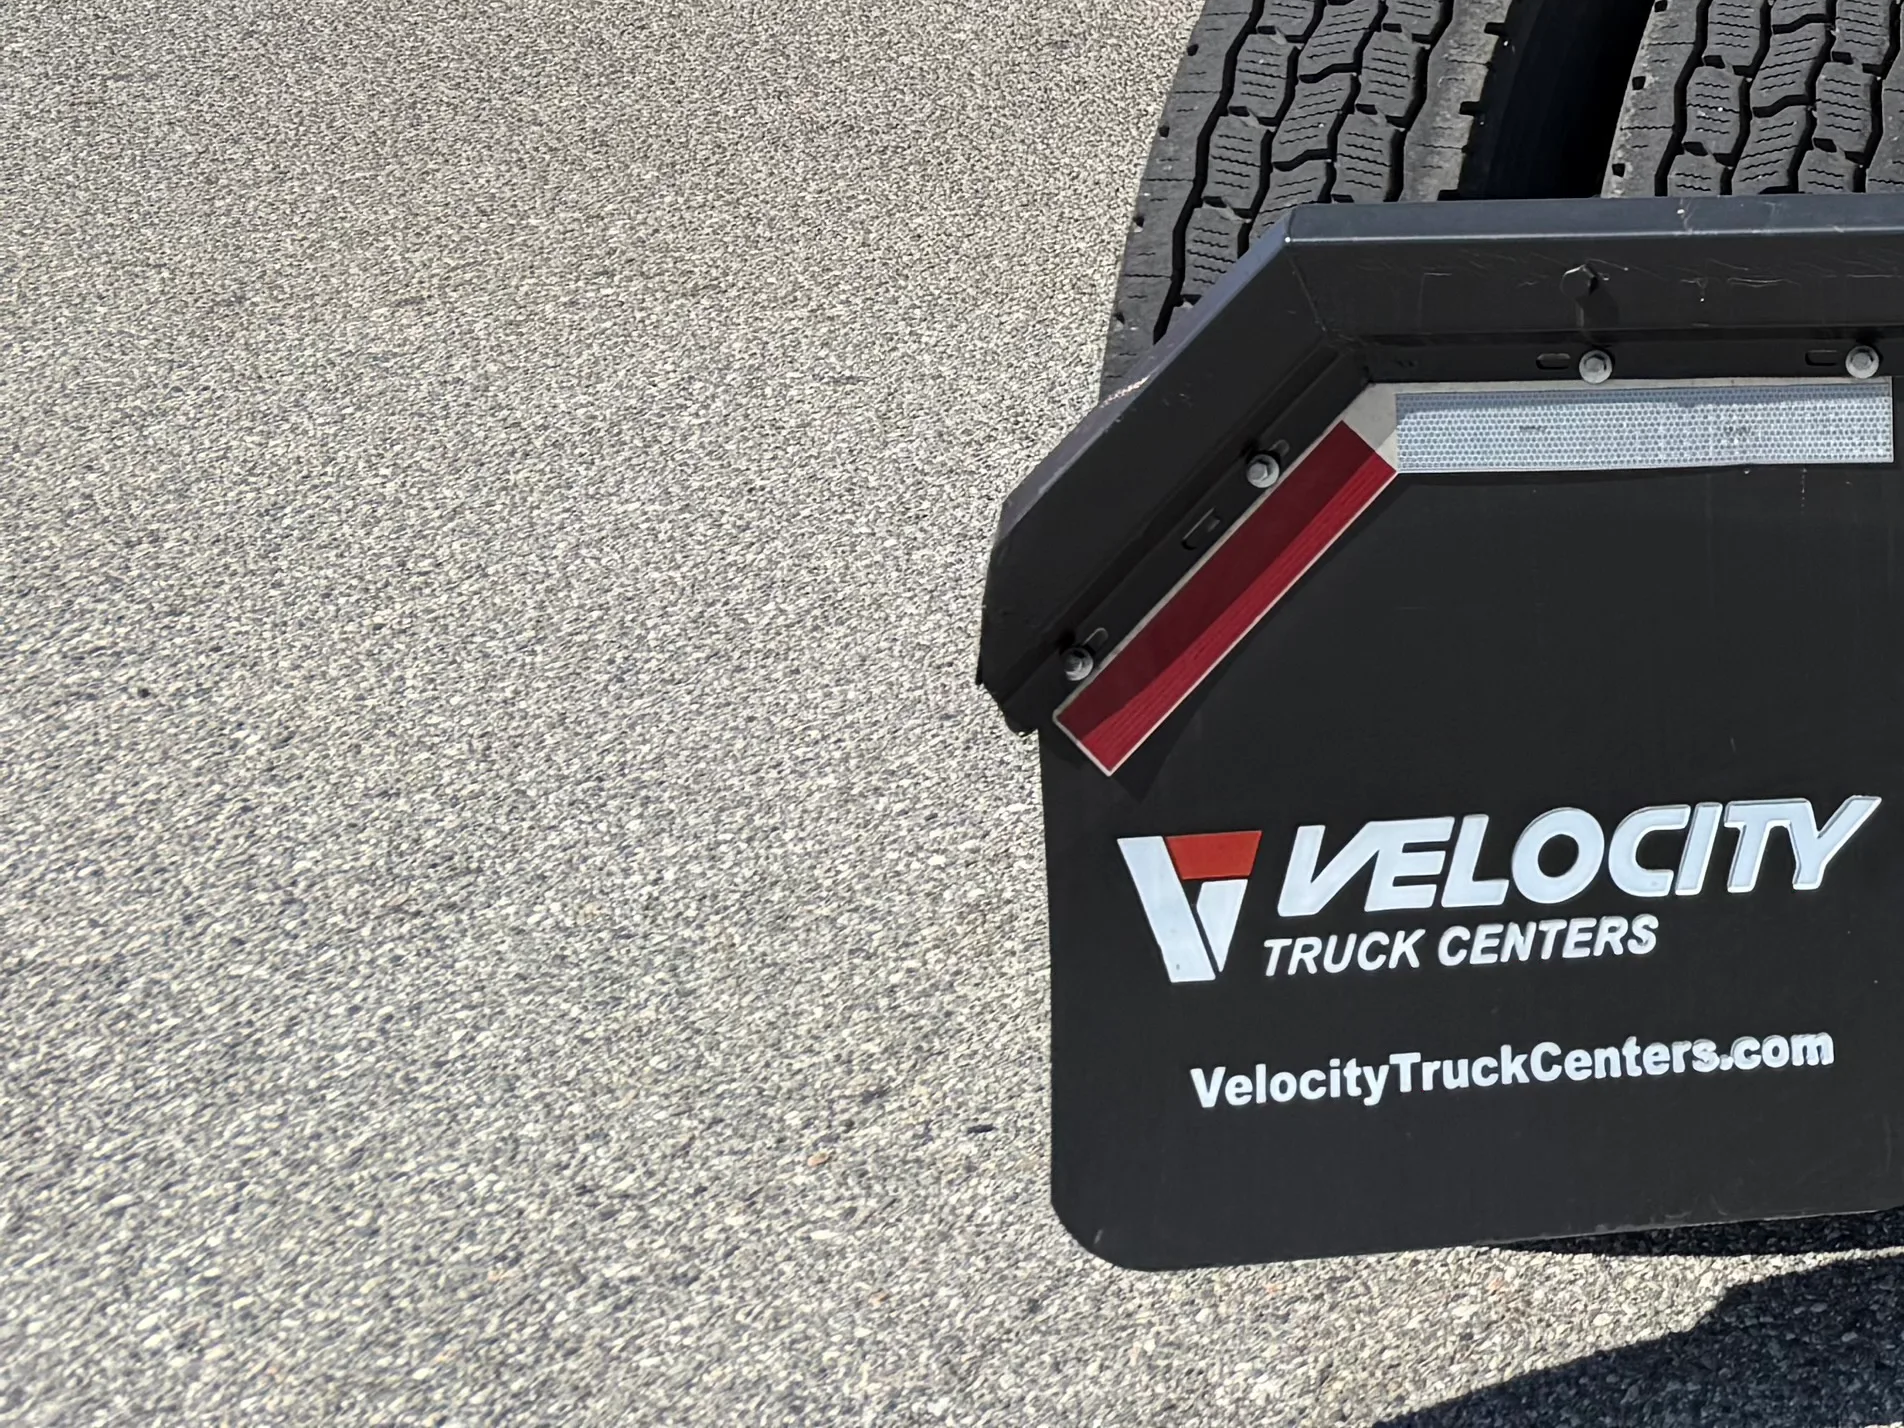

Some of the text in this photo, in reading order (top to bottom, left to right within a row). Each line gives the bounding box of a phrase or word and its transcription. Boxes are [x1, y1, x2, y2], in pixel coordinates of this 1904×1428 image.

[1278, 795, 1882, 917] VELOCITY
[1263, 914, 1659, 977] TRUCK CENTERS
[1190, 1031, 1835, 1109] VelocityTruckCenters.com
